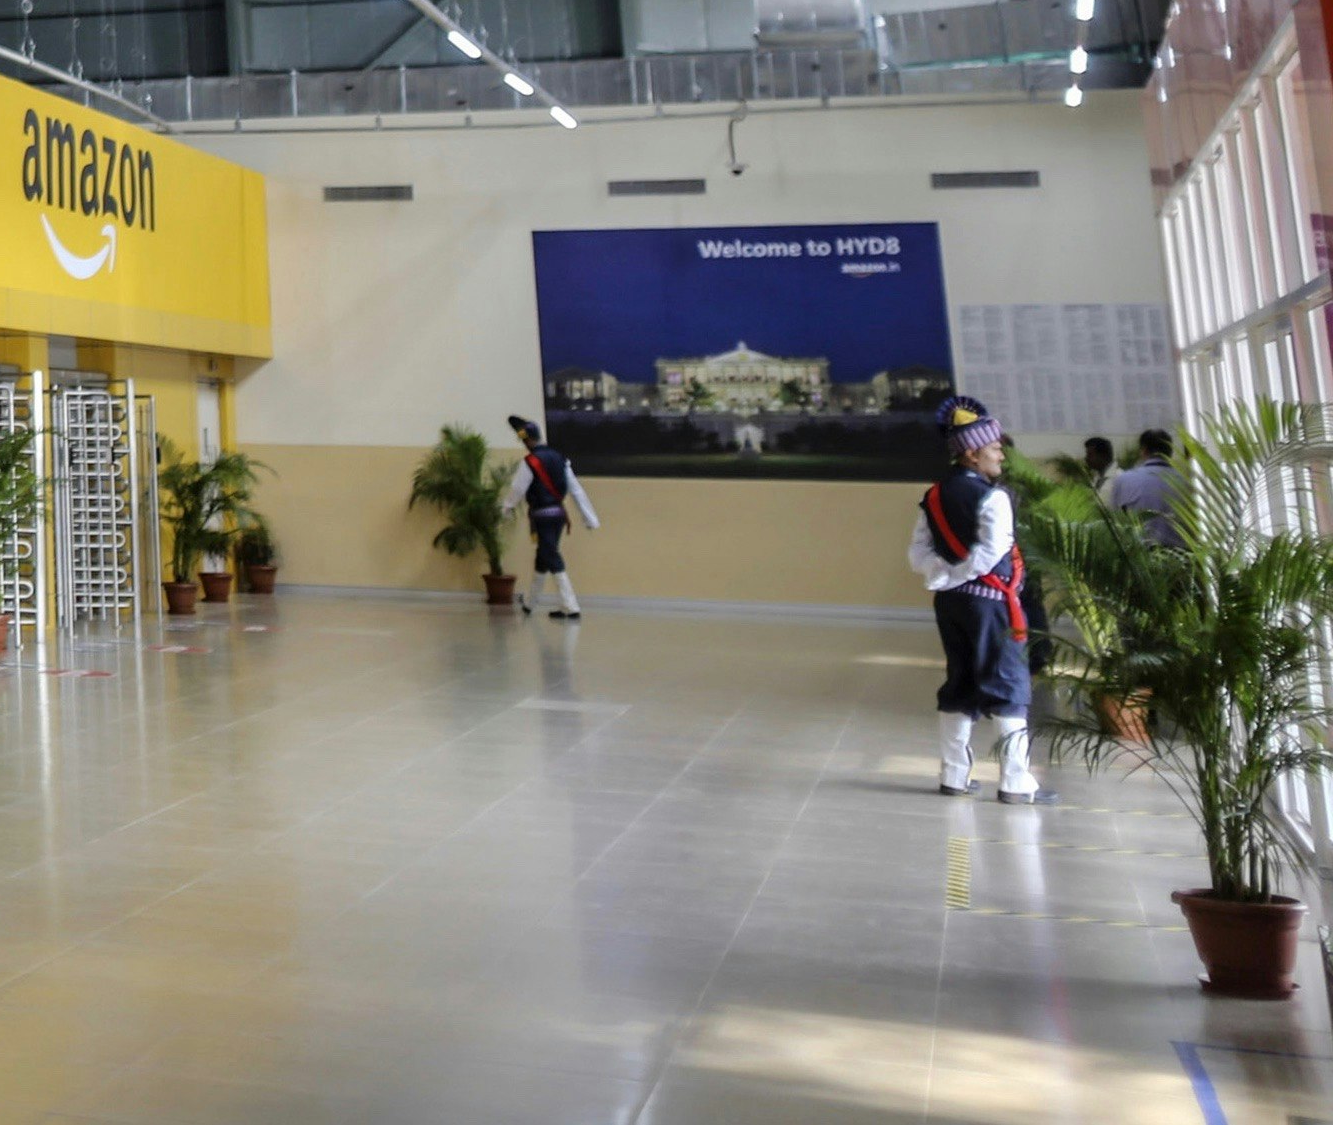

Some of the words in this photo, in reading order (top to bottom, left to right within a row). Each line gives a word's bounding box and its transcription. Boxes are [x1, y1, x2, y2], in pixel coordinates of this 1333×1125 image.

[23, 110, 154, 231] amazon
[698, 240, 802, 258] Welcome
[806, 239, 832, 257] to
[836, 236, 901, 256] HYD8
